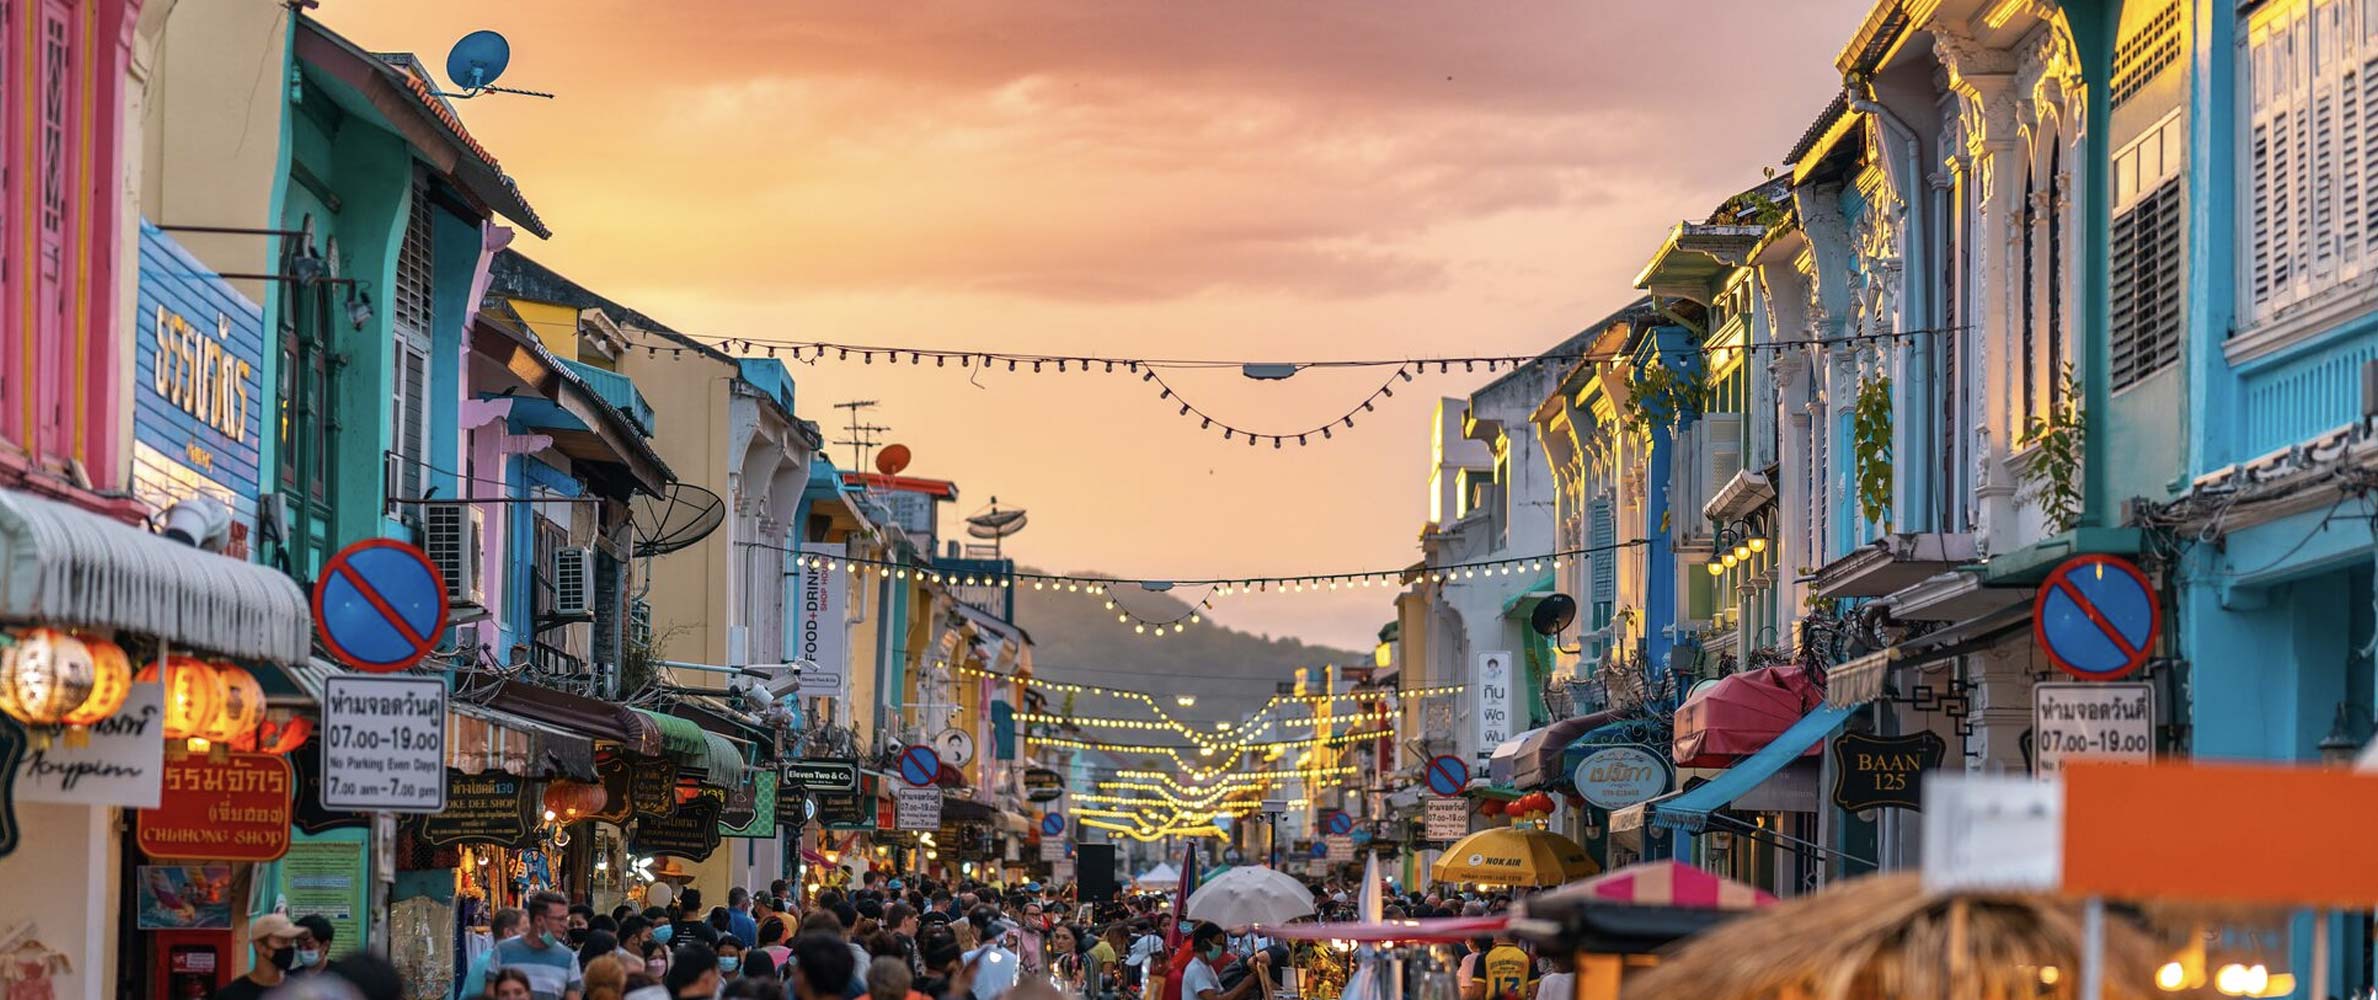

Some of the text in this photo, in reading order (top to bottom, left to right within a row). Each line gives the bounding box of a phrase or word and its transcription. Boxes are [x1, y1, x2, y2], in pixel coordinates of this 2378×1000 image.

[820, 587, 829, 611] SHOP
[331, 687, 440, 727] ห้ามจอดวันคู่
[2041, 688, 2147, 720] ห้ามจอดวันคี่
[329, 724, 439, 751] 07.00-19.00
[2041, 729, 2147, 753] 07.00-19.00
[329, 757, 437, 774] No Parking Even Days
[1856, 752, 1921, 772] BAAN
[164, 758, 284, 793] รรมจักร
[788, 770, 851, 780] Eleven Two & Co.
[1874, 772, 1906, 791] 125
[447, 799, 466, 809] OKE
[233, 828, 283, 847] SHOP
[1485, 857, 1522, 867] NOK AIR
